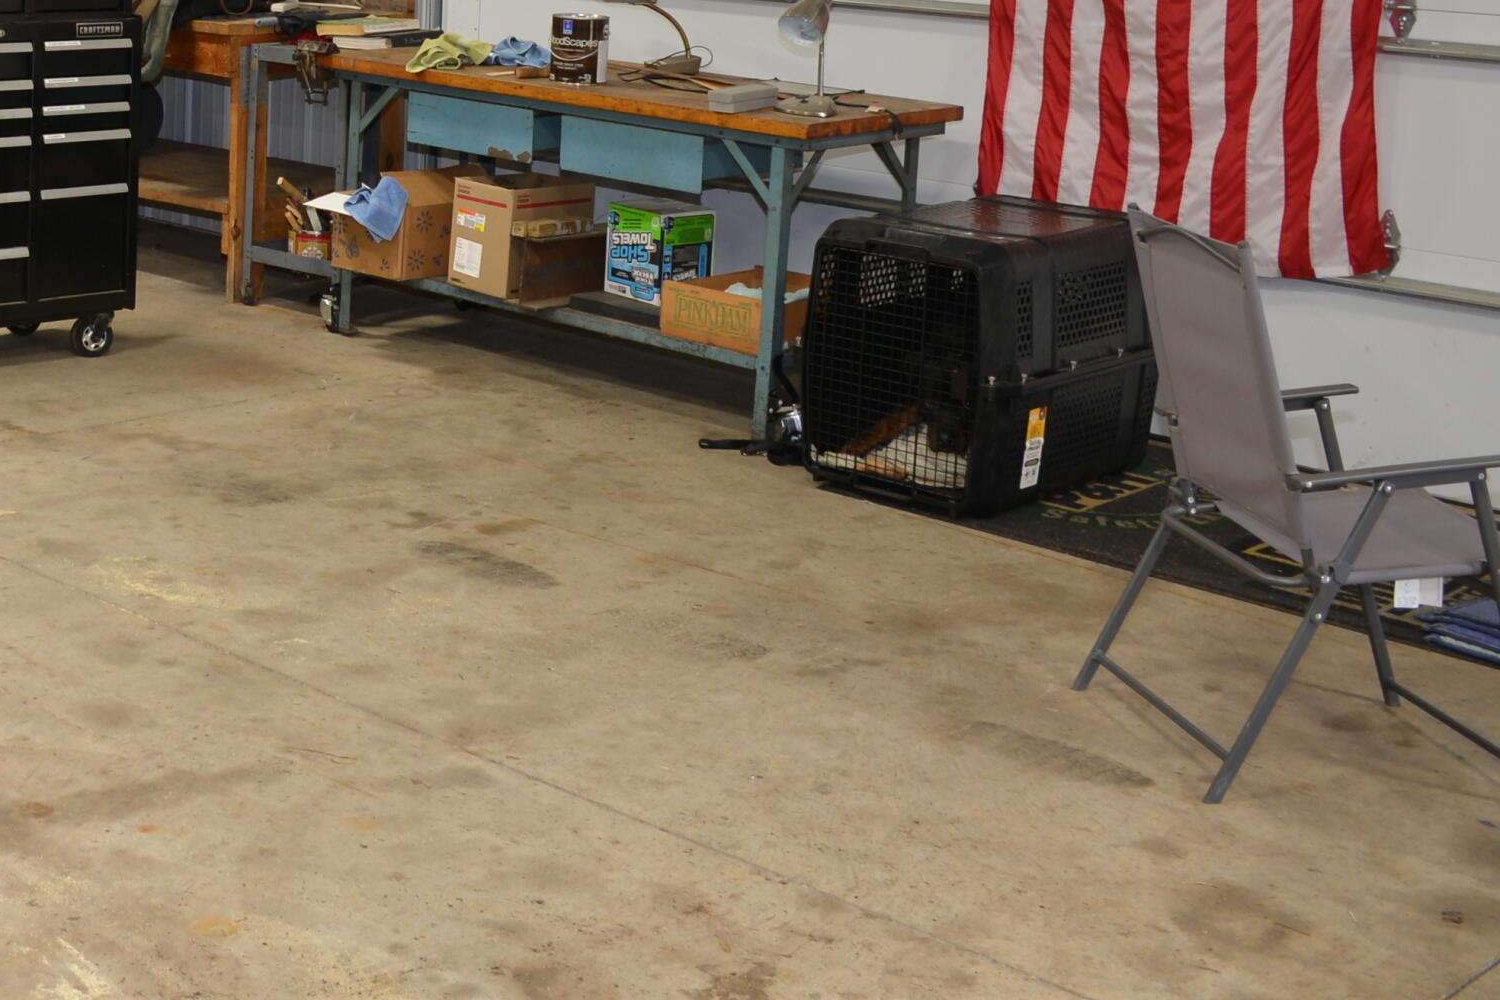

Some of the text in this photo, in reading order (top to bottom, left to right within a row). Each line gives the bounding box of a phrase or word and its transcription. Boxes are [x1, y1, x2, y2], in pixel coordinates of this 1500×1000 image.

[79, 25, 121, 35] CRAFTSMAN
[612, 232, 657, 252] TOWELS
[611, 244, 649, 263] SHOP
